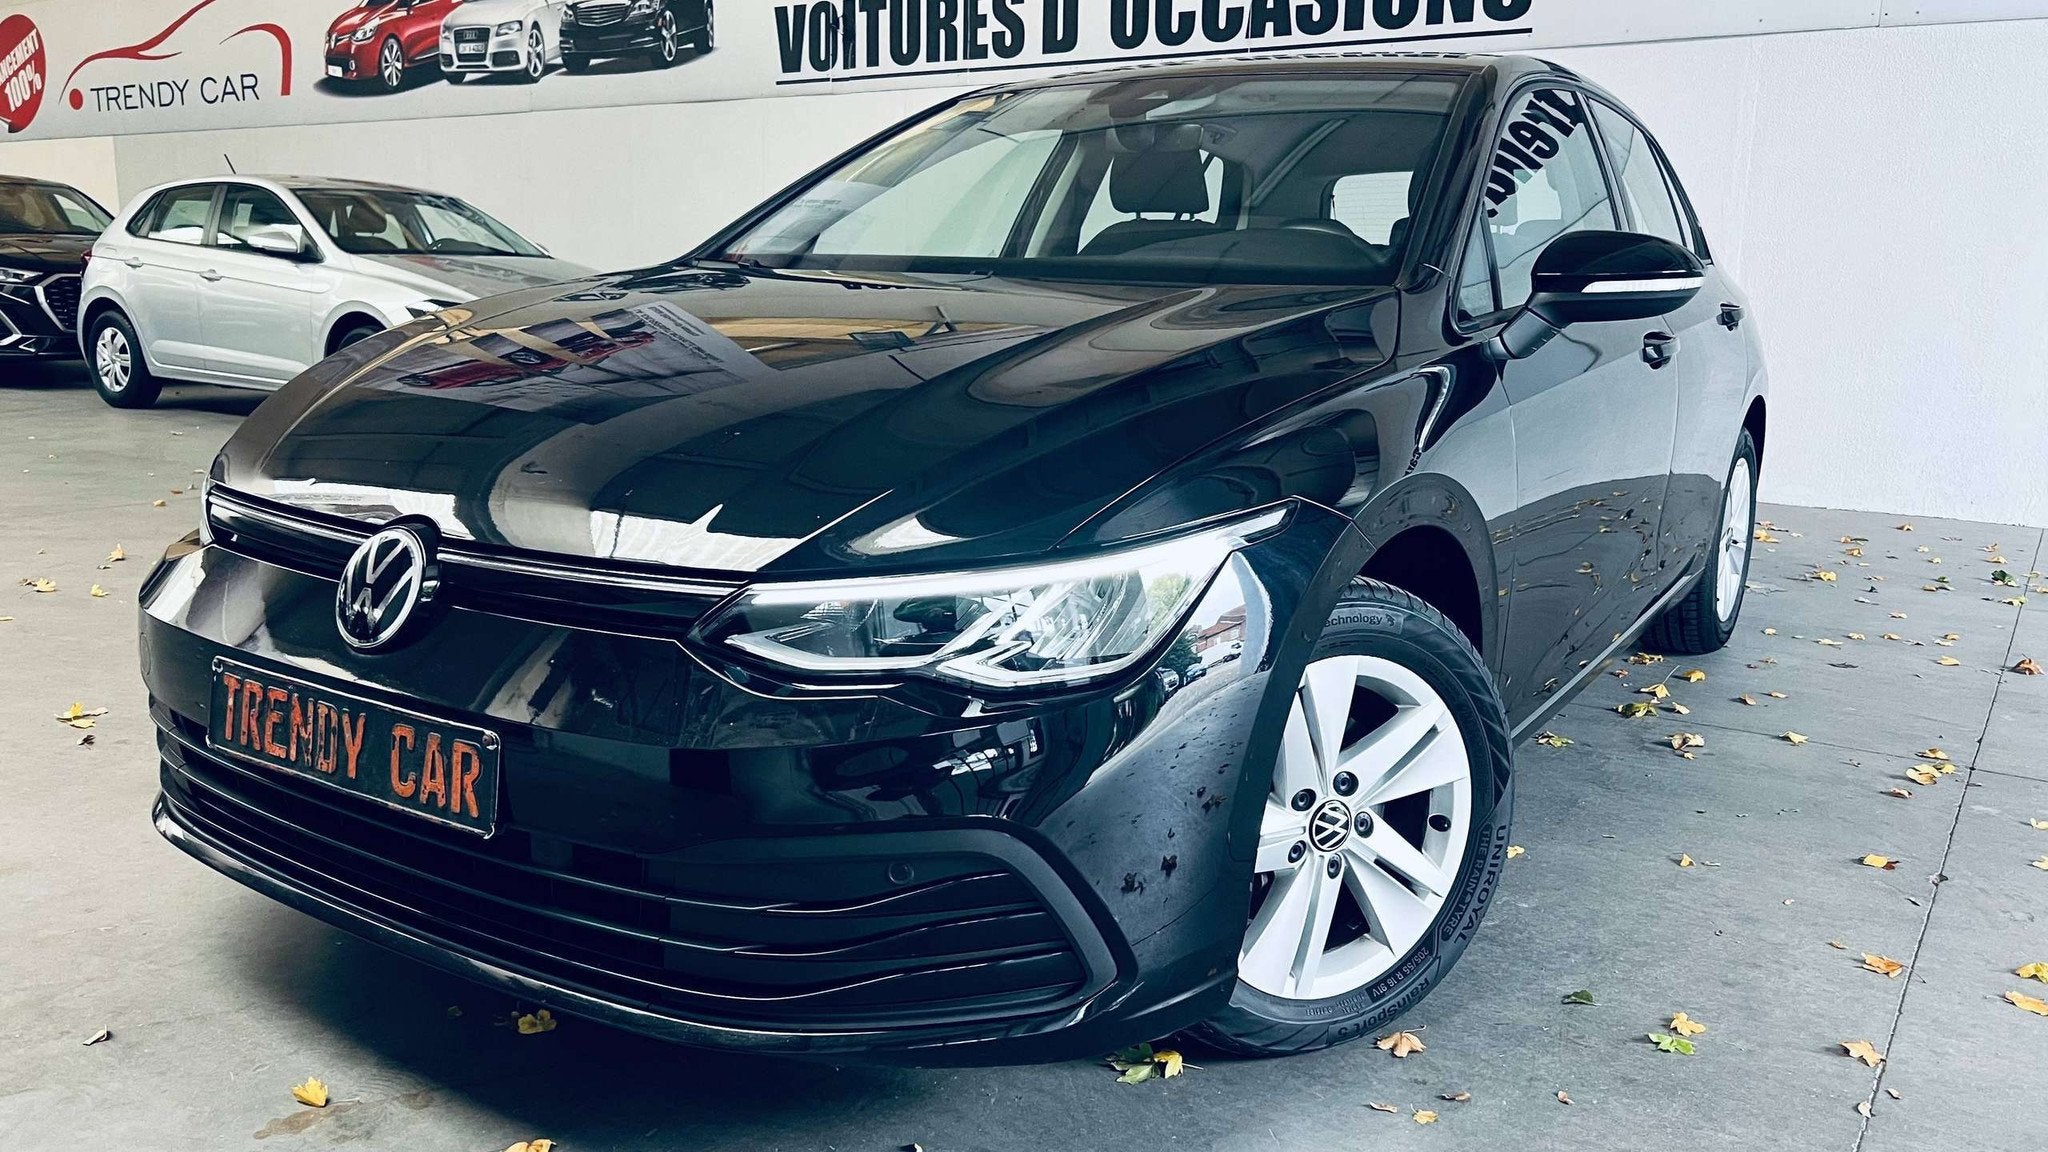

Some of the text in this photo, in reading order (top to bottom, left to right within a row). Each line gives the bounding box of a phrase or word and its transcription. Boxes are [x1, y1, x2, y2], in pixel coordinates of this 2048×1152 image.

[0, 27, 39, 87] NCEMENT
[774, 0, 1025, 73] VOITURES
[1109, 0, 1532, 50] OCCAS
[5, 60, 42, 112] 100%
[90, 73, 260, 112] TRENDY CAR
[1325, 613, 1383, 628] echnology
[223, 671, 486, 818] TRENDY CAR
[1454, 824, 1507, 943] UNIROYAL
[1466, 860, 1483, 893] RAIN
[1444, 903, 1466, 934] TYRE
[1402, 946, 1430, 974] 205/55
[1354, 977, 1431, 1030] RainSport
[1372, 984, 1388, 997] 91V
